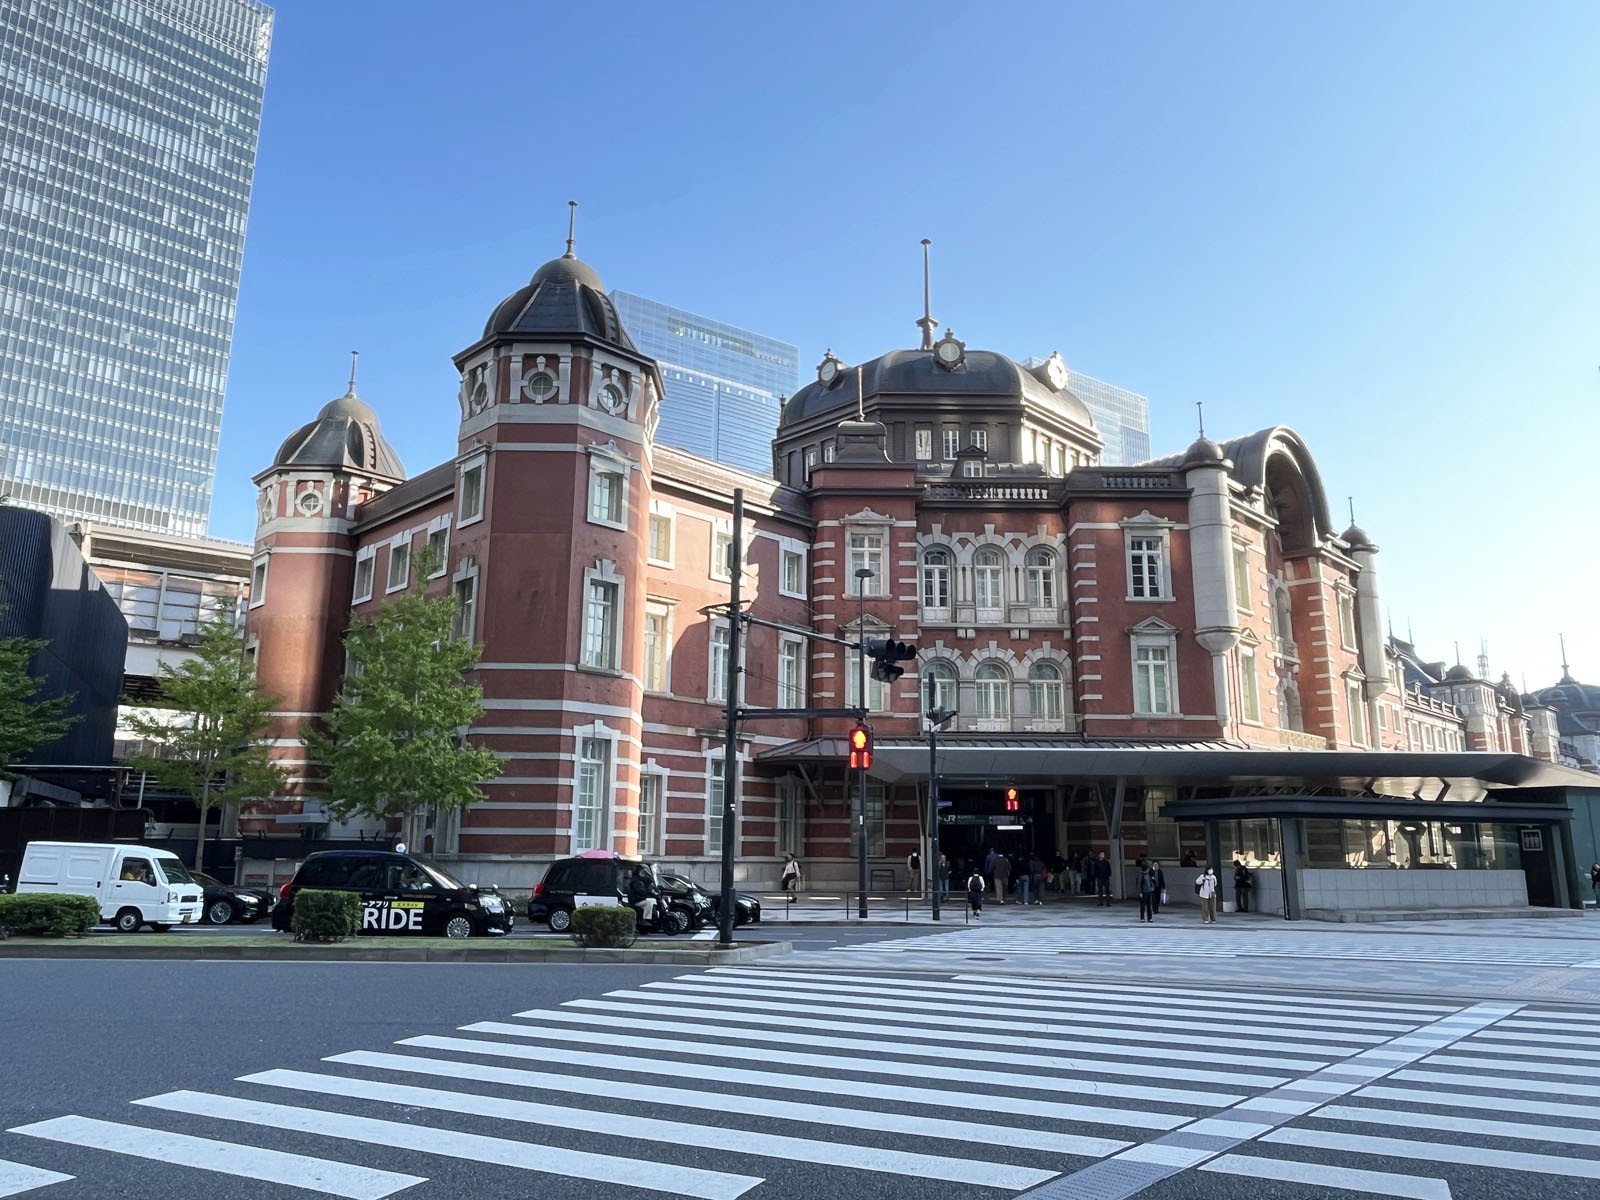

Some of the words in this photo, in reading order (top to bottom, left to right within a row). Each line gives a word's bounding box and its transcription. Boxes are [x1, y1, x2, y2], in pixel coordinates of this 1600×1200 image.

[943, 814, 956, 822] JR
[359, 900, 389, 908] ーアプリ
[363, 908, 424, 930] RIDE
